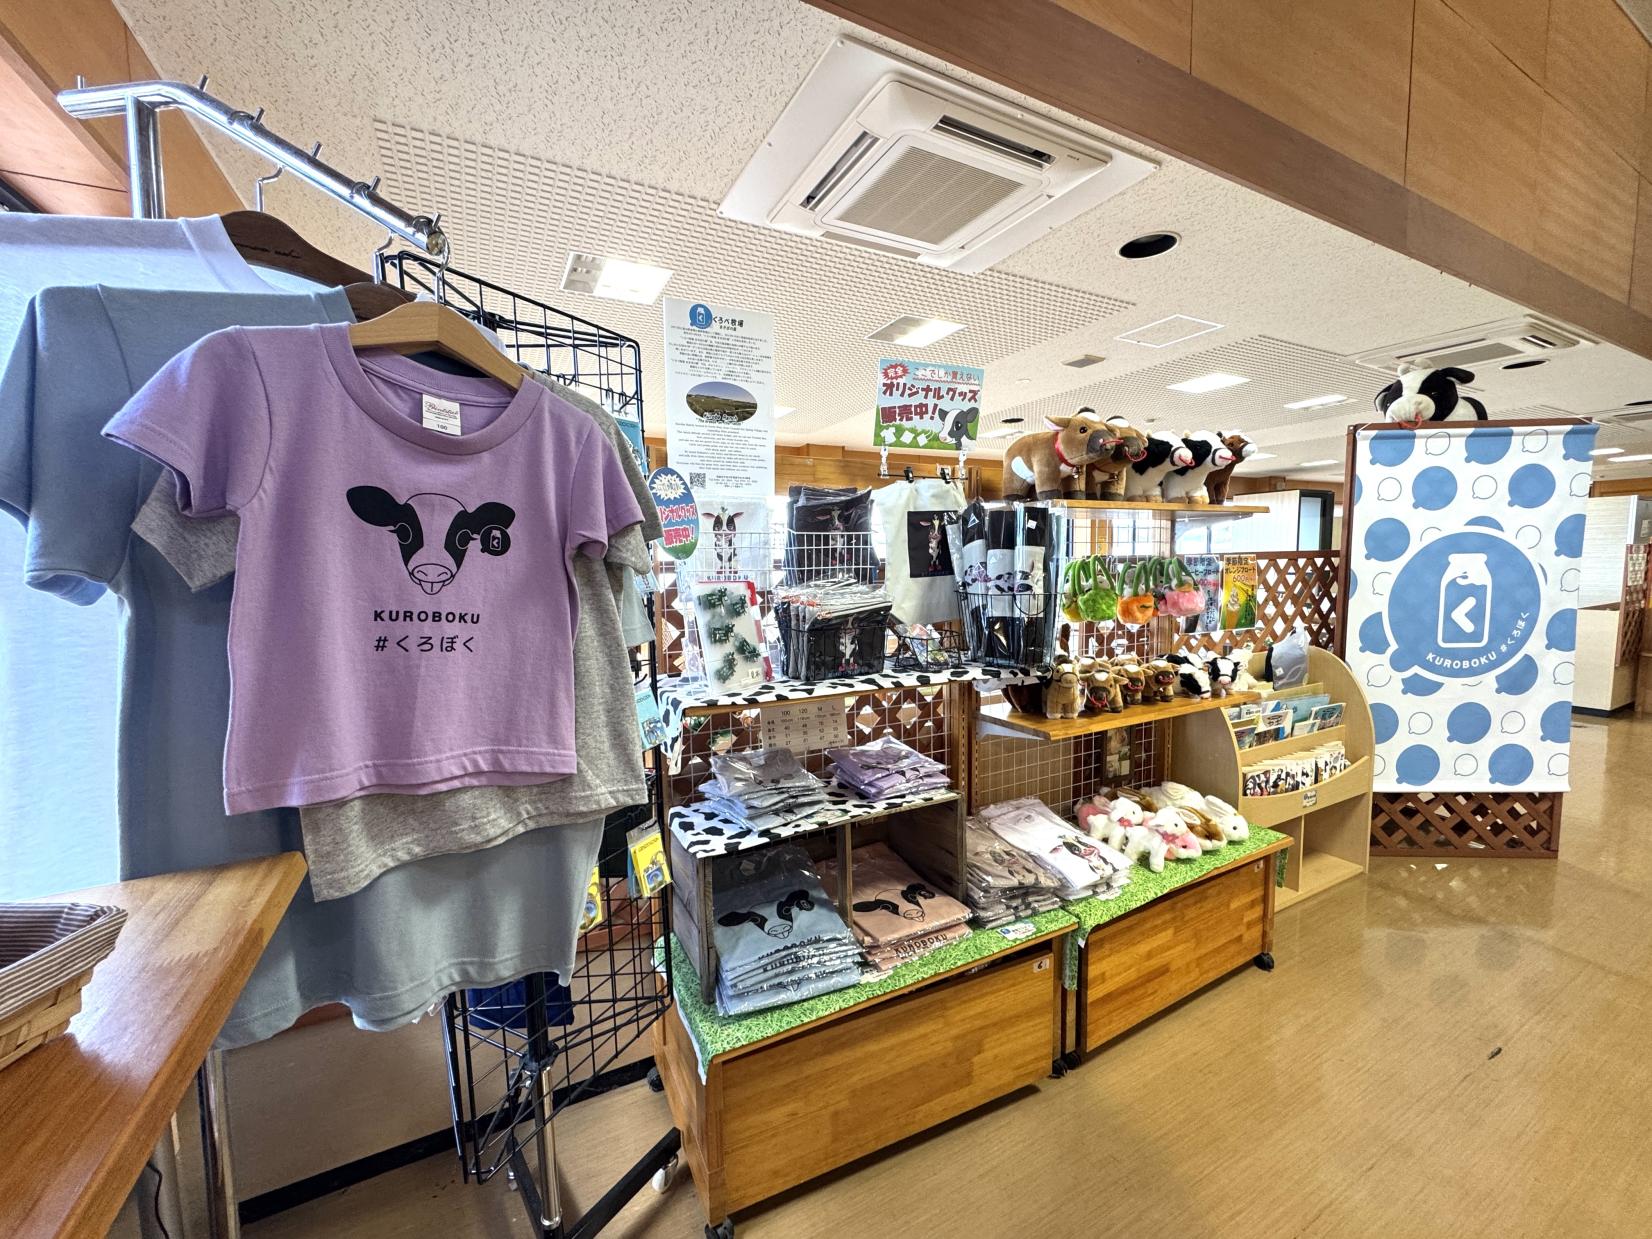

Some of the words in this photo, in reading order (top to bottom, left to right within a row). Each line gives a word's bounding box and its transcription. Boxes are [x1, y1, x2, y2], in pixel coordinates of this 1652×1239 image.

[882, 382, 980, 403] オリジナルグッズ
[373, 609, 480, 624] KUROBOKU
[1500, 612, 1530, 653] #くろぼく
[373, 635, 475, 653] #くろぼく
[1426, 651, 1497, 669] KUROBOKU
[894, 933, 948, 954] KUROBOKU
